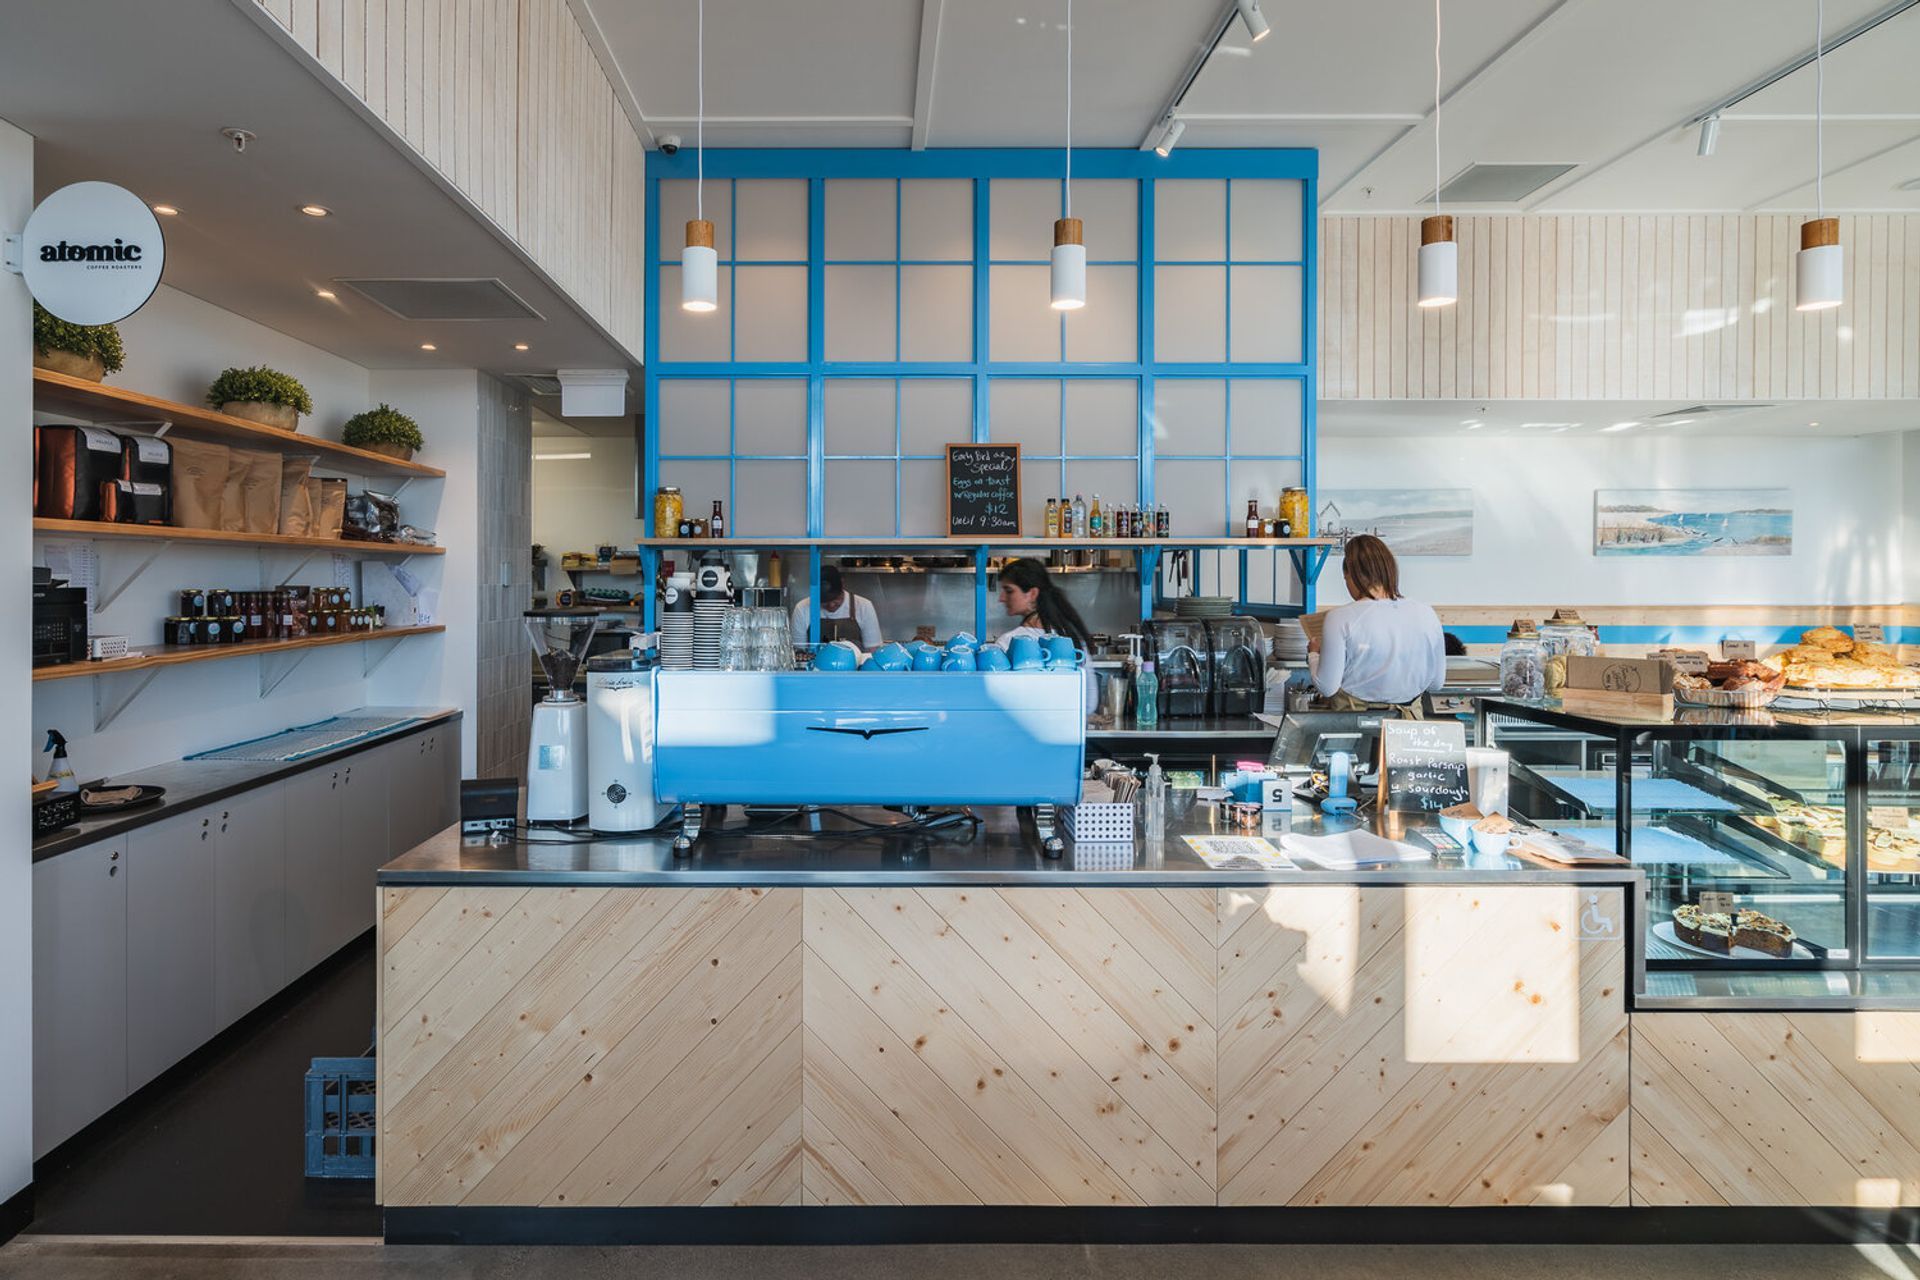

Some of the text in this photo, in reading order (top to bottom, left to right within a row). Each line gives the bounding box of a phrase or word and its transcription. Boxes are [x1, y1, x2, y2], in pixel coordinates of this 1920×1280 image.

[40, 238, 142, 262] atomic
[984, 502, 1008, 515] $12
[1387, 723, 1437, 740] Soup of
[1412, 737, 1453, 752] the day
[1388, 752, 1421, 765] Roast
[1407, 771, 1446, 781] garlic
